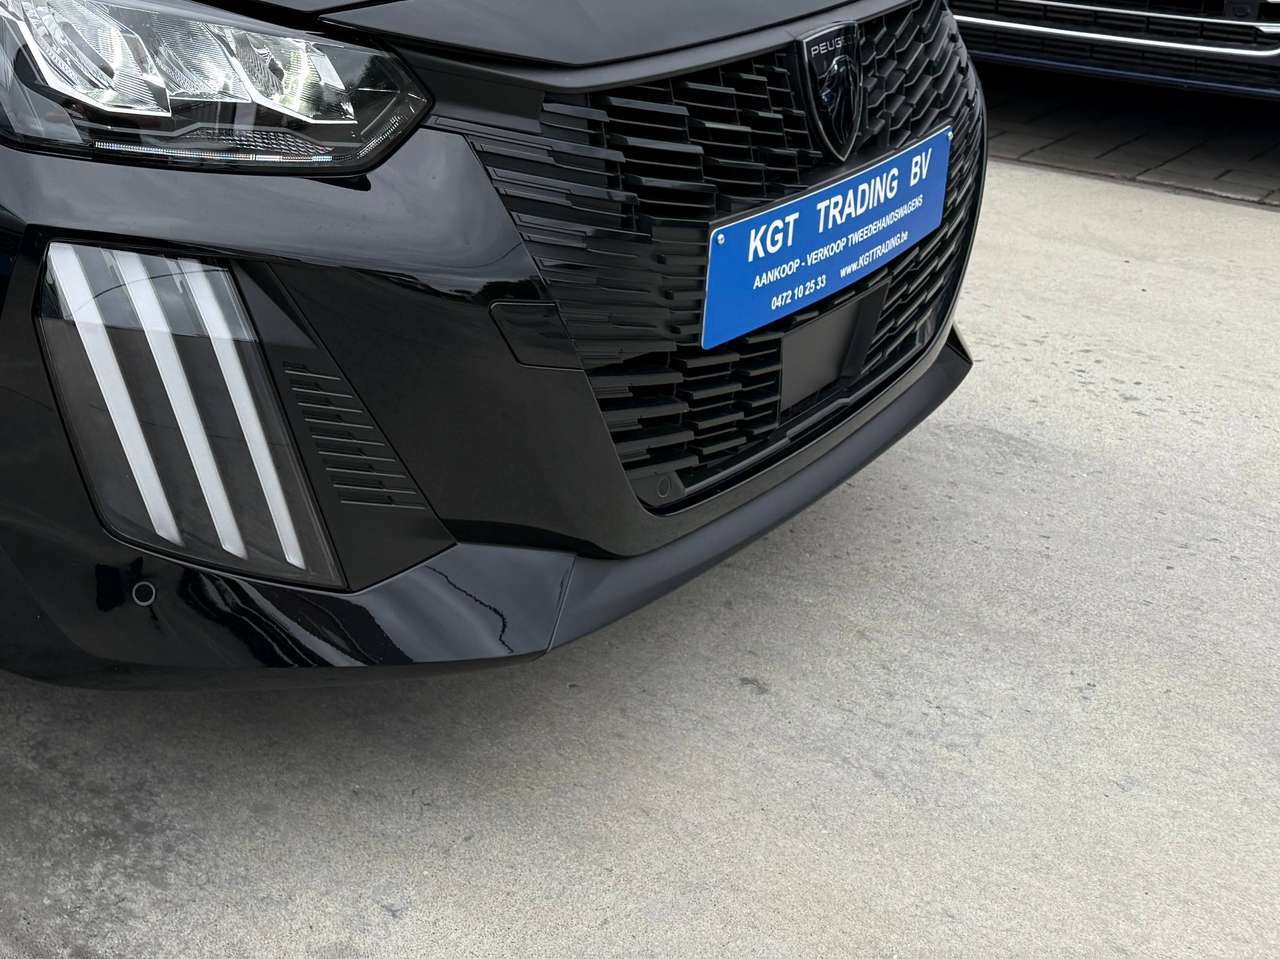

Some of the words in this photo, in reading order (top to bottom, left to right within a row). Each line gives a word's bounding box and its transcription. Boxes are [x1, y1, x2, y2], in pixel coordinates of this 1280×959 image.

[747, 212, 800, 262] KGT
[816, 167, 899, 233] TRADING
[909, 147, 933, 187] BV
[752, 259, 801, 290] AANKOOP
[806, 237, 847, 267] VERKOOP
[847, 194, 923, 247] TWEEDEHANDSWAGENS
[771, 290, 792, 310] 0472
[794, 286, 804, 301] 10
[805, 280, 816, 296] 25
[816, 274, 827, 290] 33
[840, 231, 909, 279] www.KGTTRADING.be
